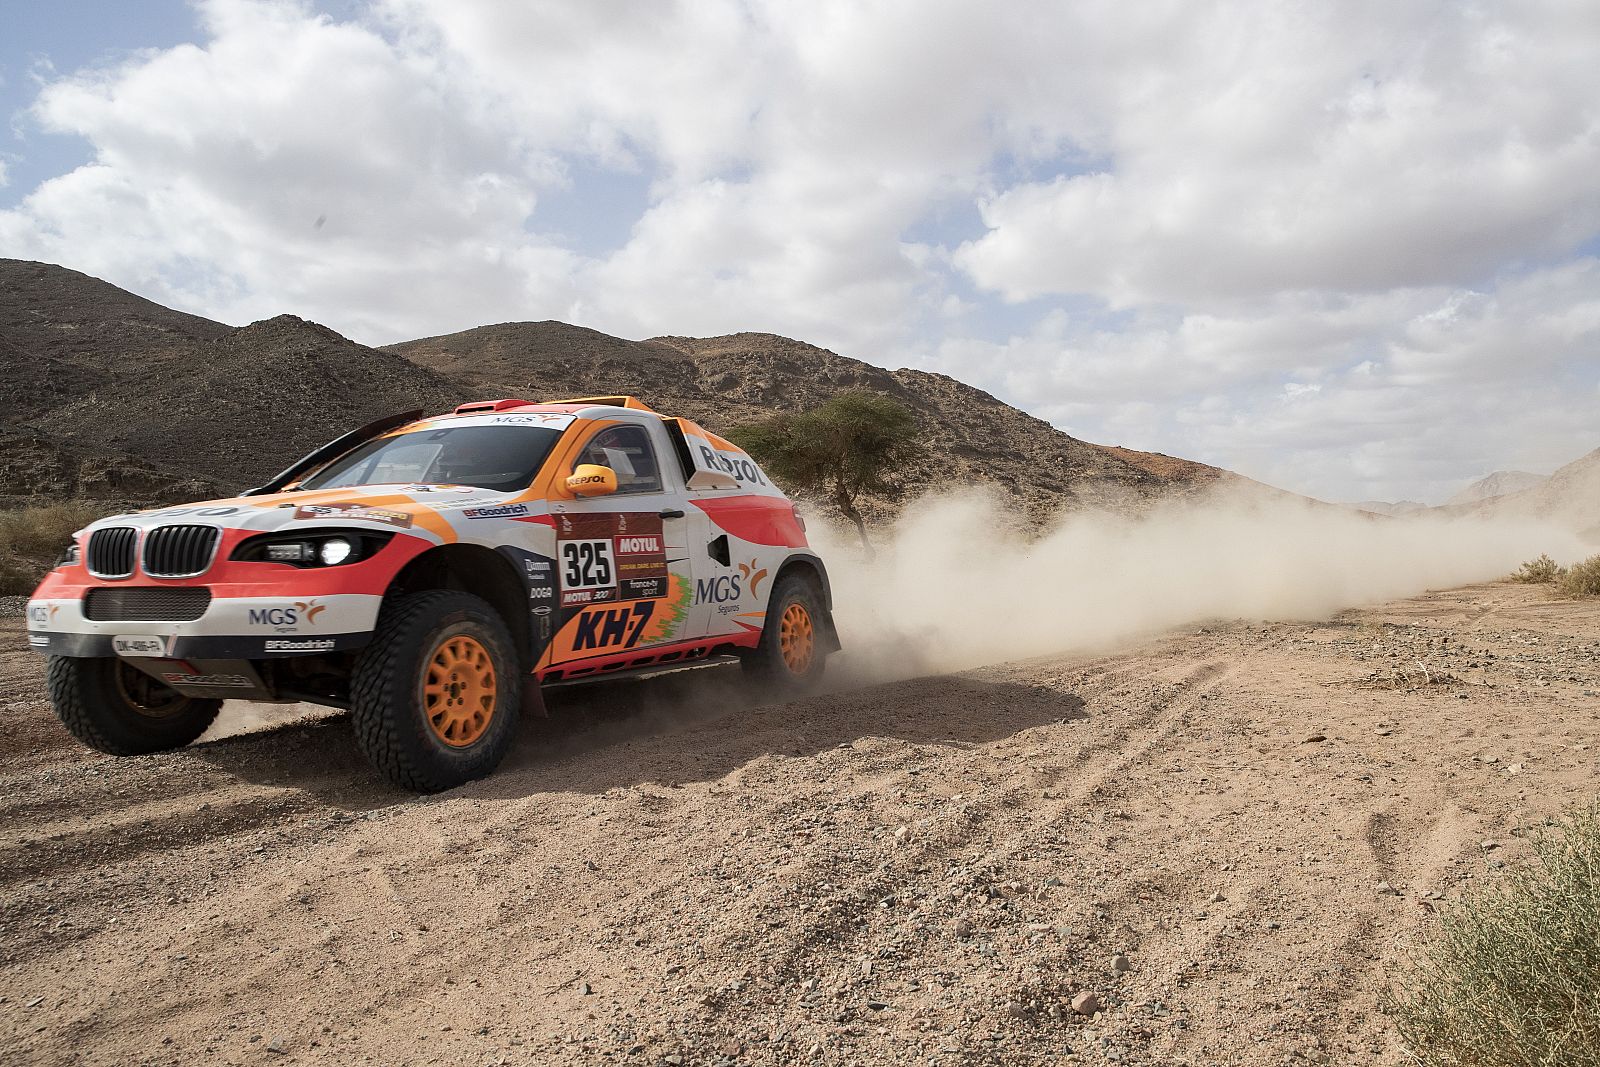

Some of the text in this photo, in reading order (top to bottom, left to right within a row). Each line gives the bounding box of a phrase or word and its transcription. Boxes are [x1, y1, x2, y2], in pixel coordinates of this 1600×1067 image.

[491, 416, 536, 424] MGS
[699, 445, 766, 487] RPSOL
[567, 475, 606, 487] REPSOL
[463, 504, 528, 517] BFGoodrich
[620, 538, 660, 553] MOTUL
[563, 542, 611, 587] 325
[530, 587, 552, 599] DOGA
[641, 588, 658, 598] sport
[695, 575, 741, 605] MGS
[563, 592, 592, 603] MOTUL
[717, 604, 740, 615] Seguros
[249, 608, 298, 625] MGS
[572, 601, 655, 651] KH-7
[264, 640, 335, 650] BFGoodrich
